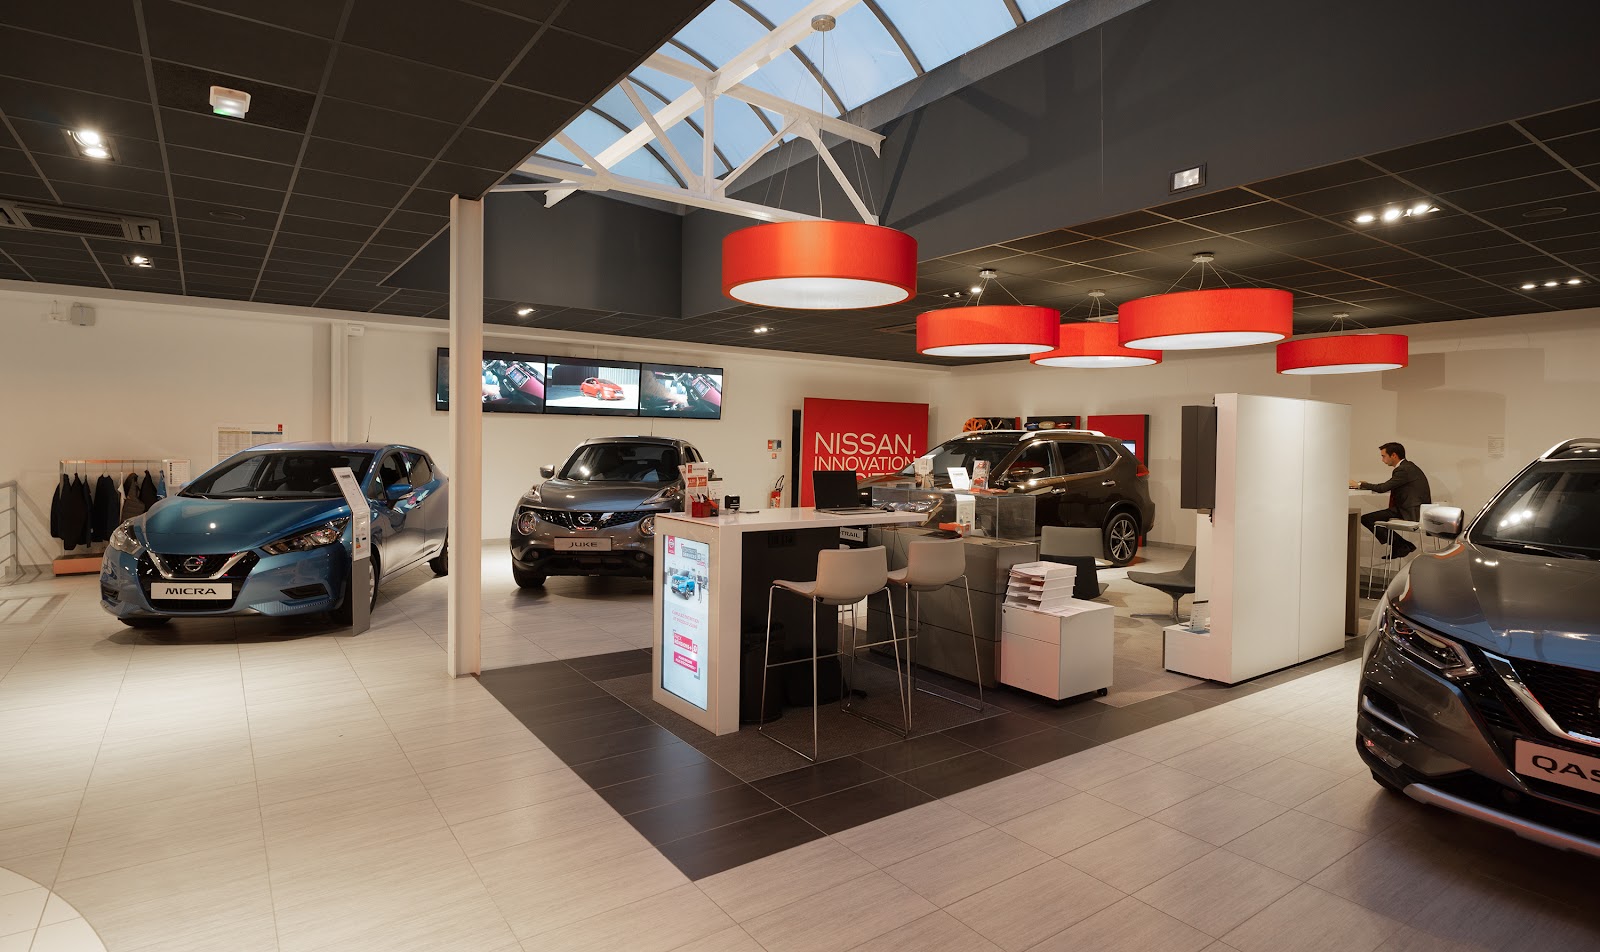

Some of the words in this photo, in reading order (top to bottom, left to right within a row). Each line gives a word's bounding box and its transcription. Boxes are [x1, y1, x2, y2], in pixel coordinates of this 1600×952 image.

[814, 431, 917, 455] NISSAN.
[814, 456, 916, 471] INNOVATION
[568, 541, 598, 549] JUKE
[165, 587, 217, 595] MICRA
